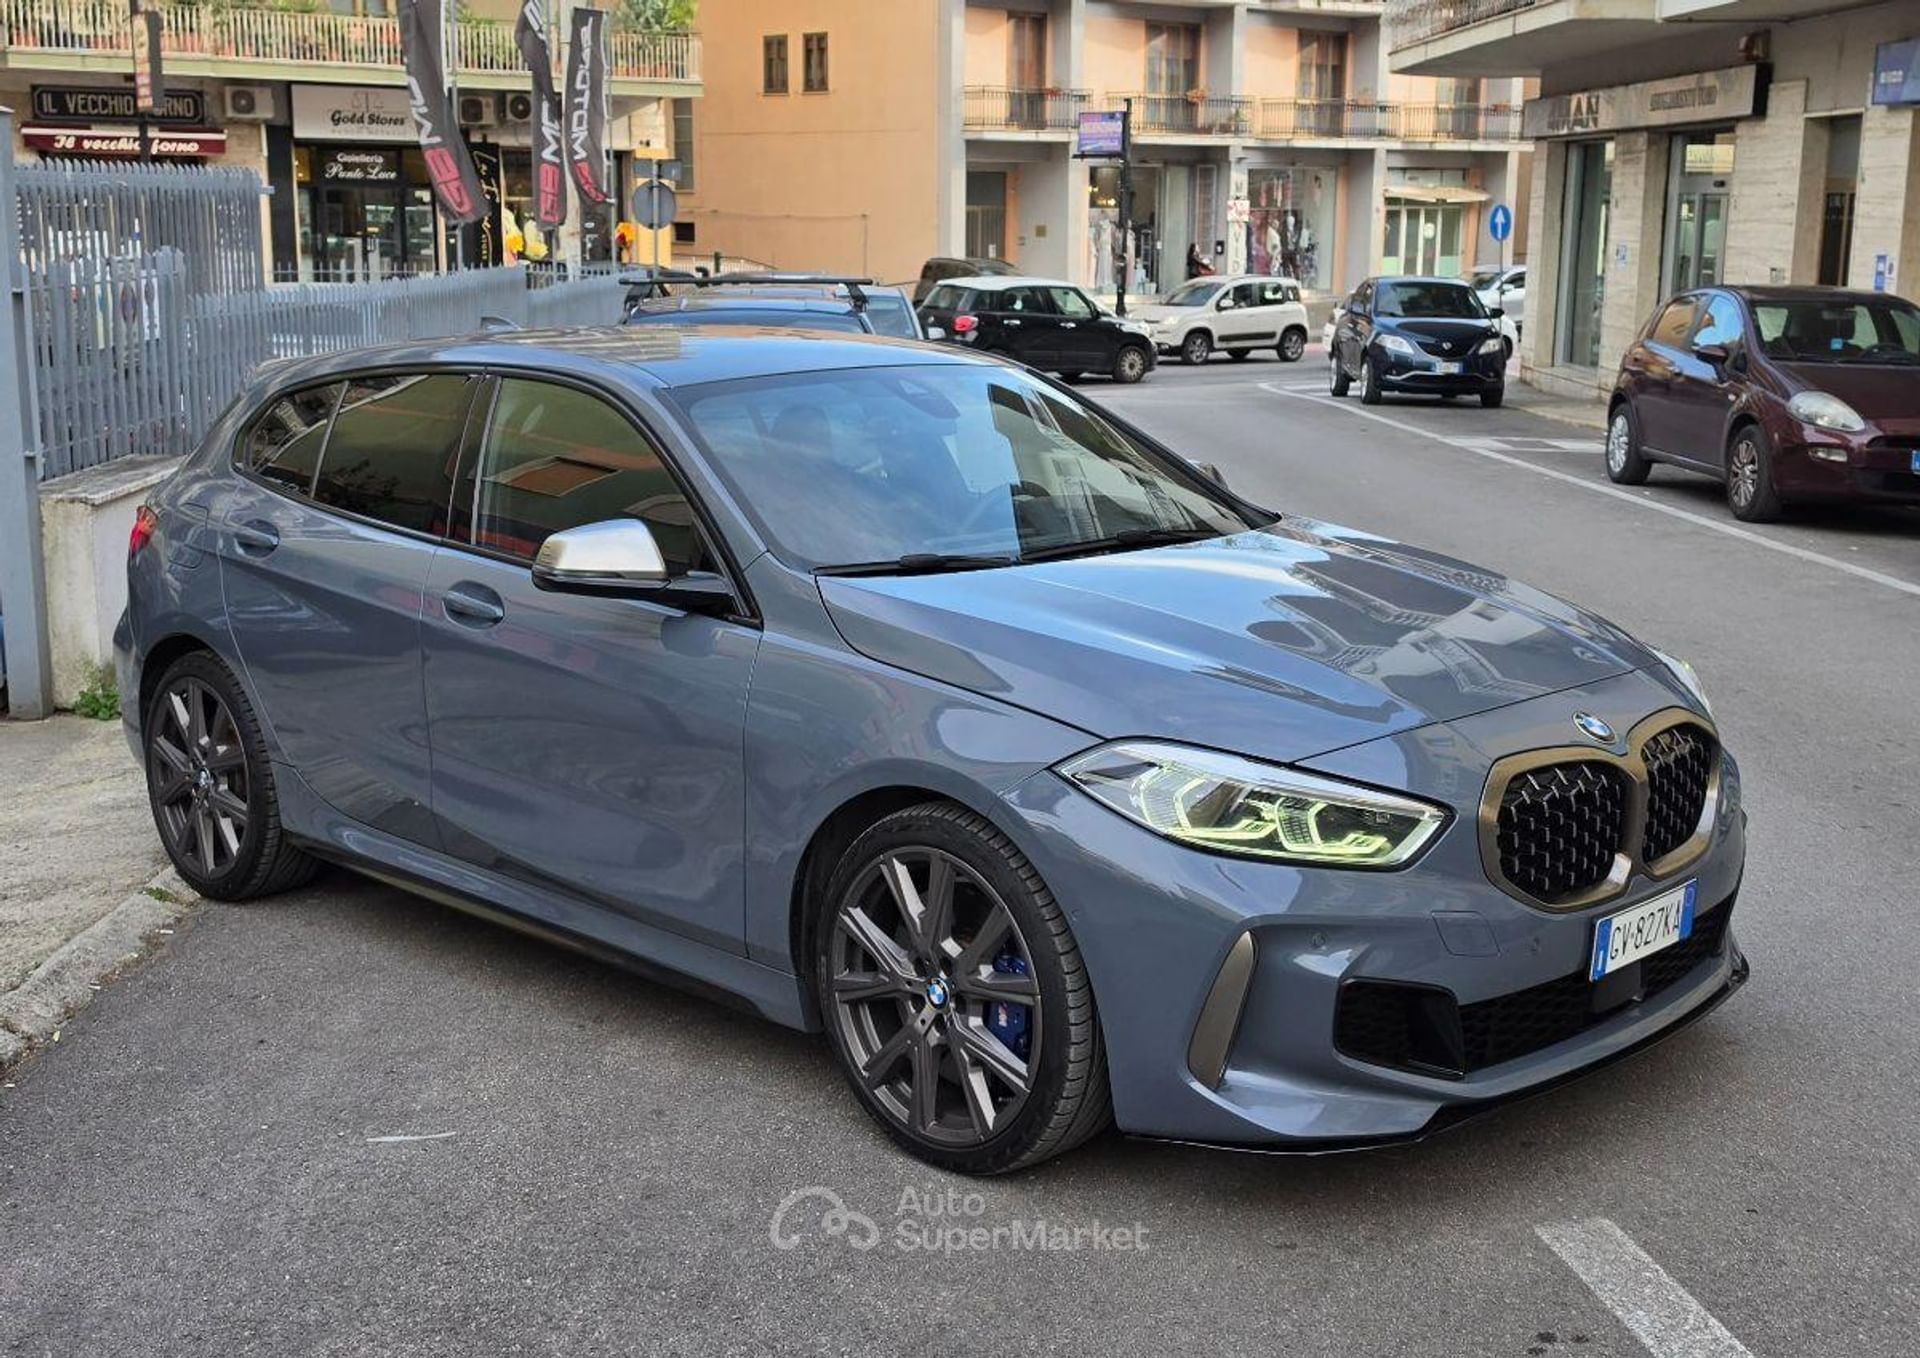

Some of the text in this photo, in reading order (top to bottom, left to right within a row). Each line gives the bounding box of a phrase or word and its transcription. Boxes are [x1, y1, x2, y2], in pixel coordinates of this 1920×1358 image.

[42, 93, 57, 113] IL
[65, 93, 134, 115] VECCHIO
[331, 110, 405, 126] Gold Stores
[54, 136, 75, 149] Il
[150, 138, 199, 154] forno
[325, 163, 397, 179] Punto Luce
